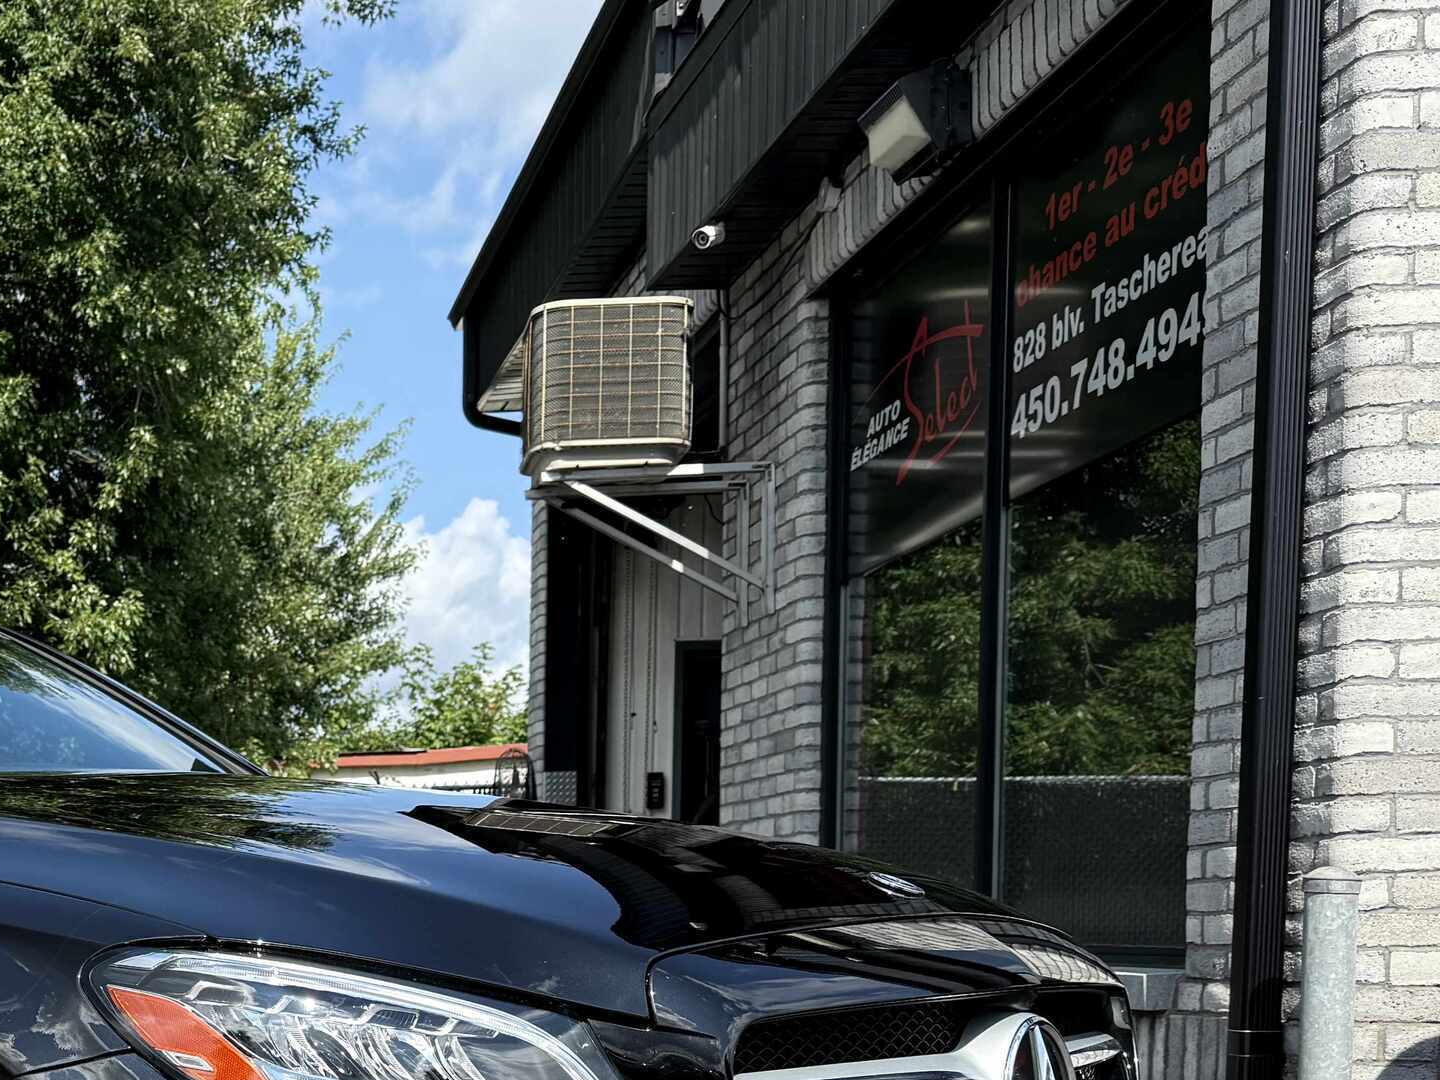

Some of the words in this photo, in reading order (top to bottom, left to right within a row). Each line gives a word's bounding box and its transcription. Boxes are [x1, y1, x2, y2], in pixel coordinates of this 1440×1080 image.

[1045, 182, 1082, 231] 1er
[1103, 144, 1134, 190] 2e
[1158, 98, 1193, 146] 3e
[1016, 231, 1097, 307] chance
[1105, 200, 1136, 247] au
[895, 299, 985, 486] Select
[1010, 291, 1208, 439] 450.748.494
[1012, 322, 1047, 373] 828
[1051, 305, 1085, 350] blv.
[849, 416, 911, 472] ÉLÉGANCE
[866, 400, 902, 438] AUTO
